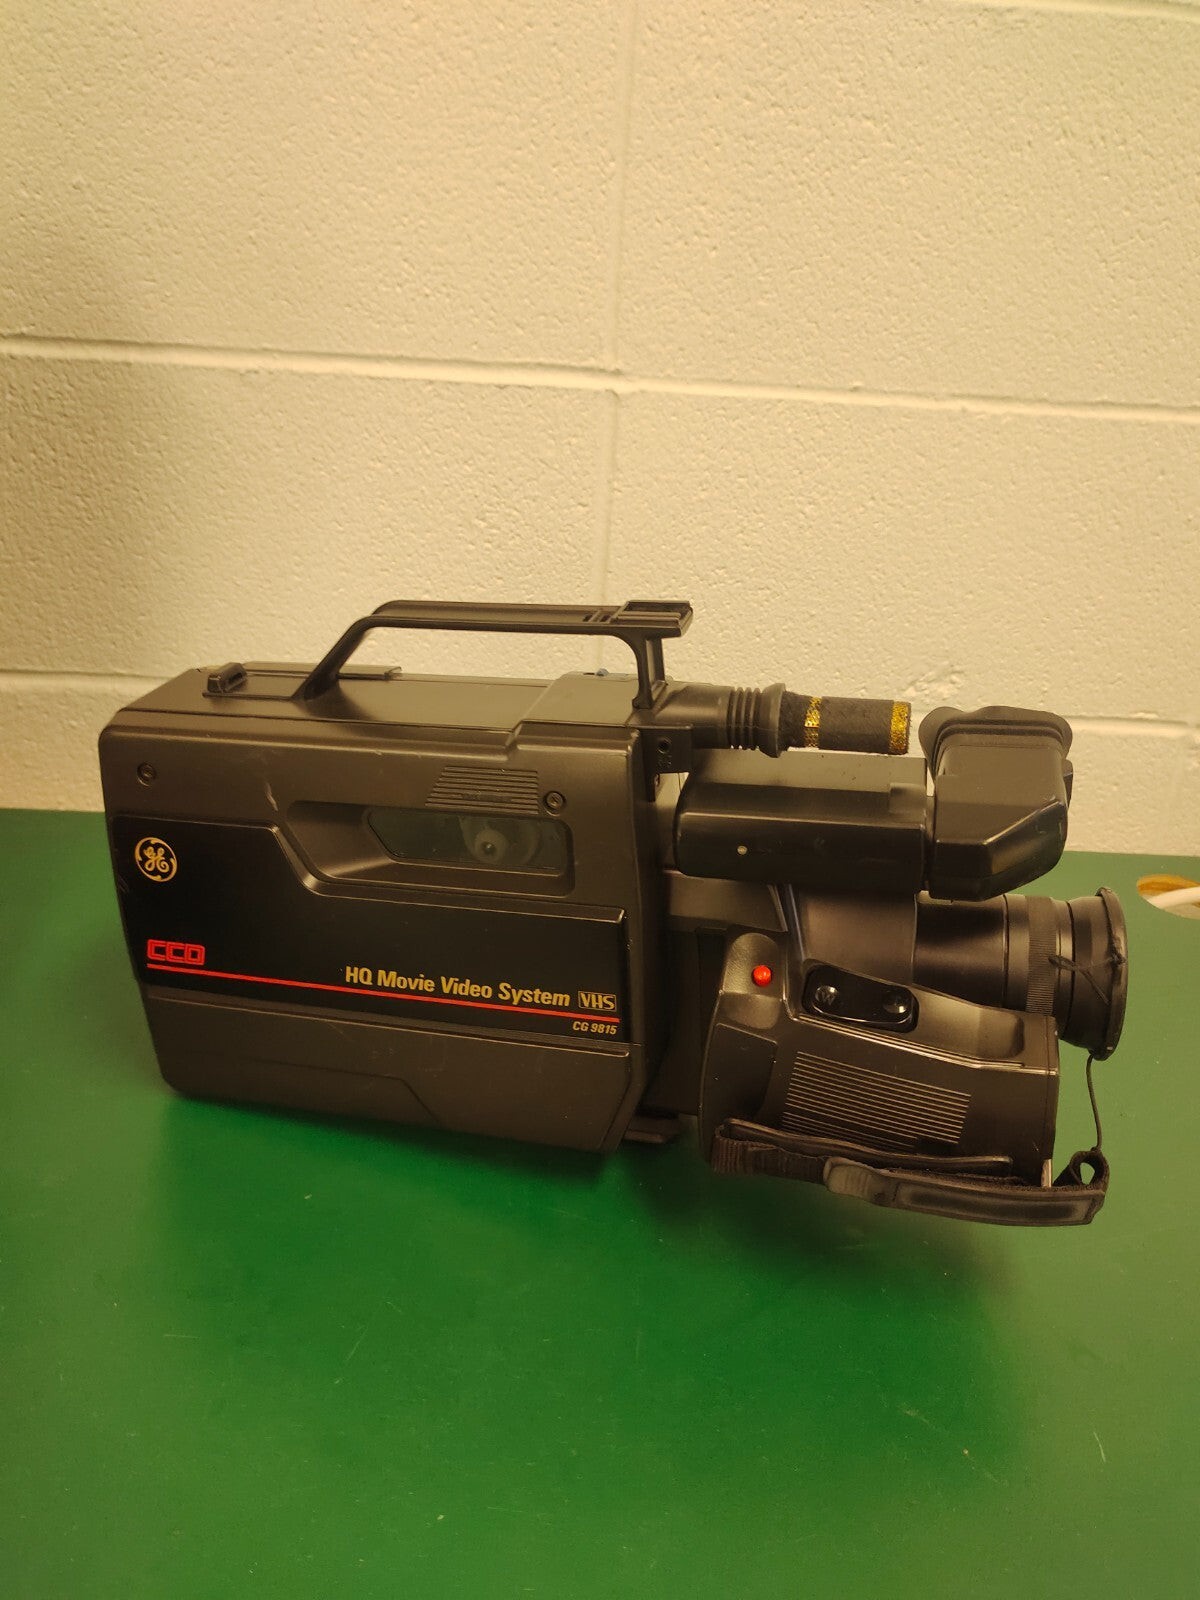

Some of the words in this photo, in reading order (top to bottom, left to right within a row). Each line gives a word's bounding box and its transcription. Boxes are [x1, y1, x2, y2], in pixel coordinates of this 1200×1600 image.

[147, 939, 206, 966] CCD
[345, 966, 373, 986] HQ
[377, 969, 436, 992] Movie
[440, 976, 493, 999] Video
[498, 982, 571, 1007] System
[578, 990, 617, 1012] VHS
[572, 1021, 589, 1032] CG
[590, 1023, 618, 1035] 9815
